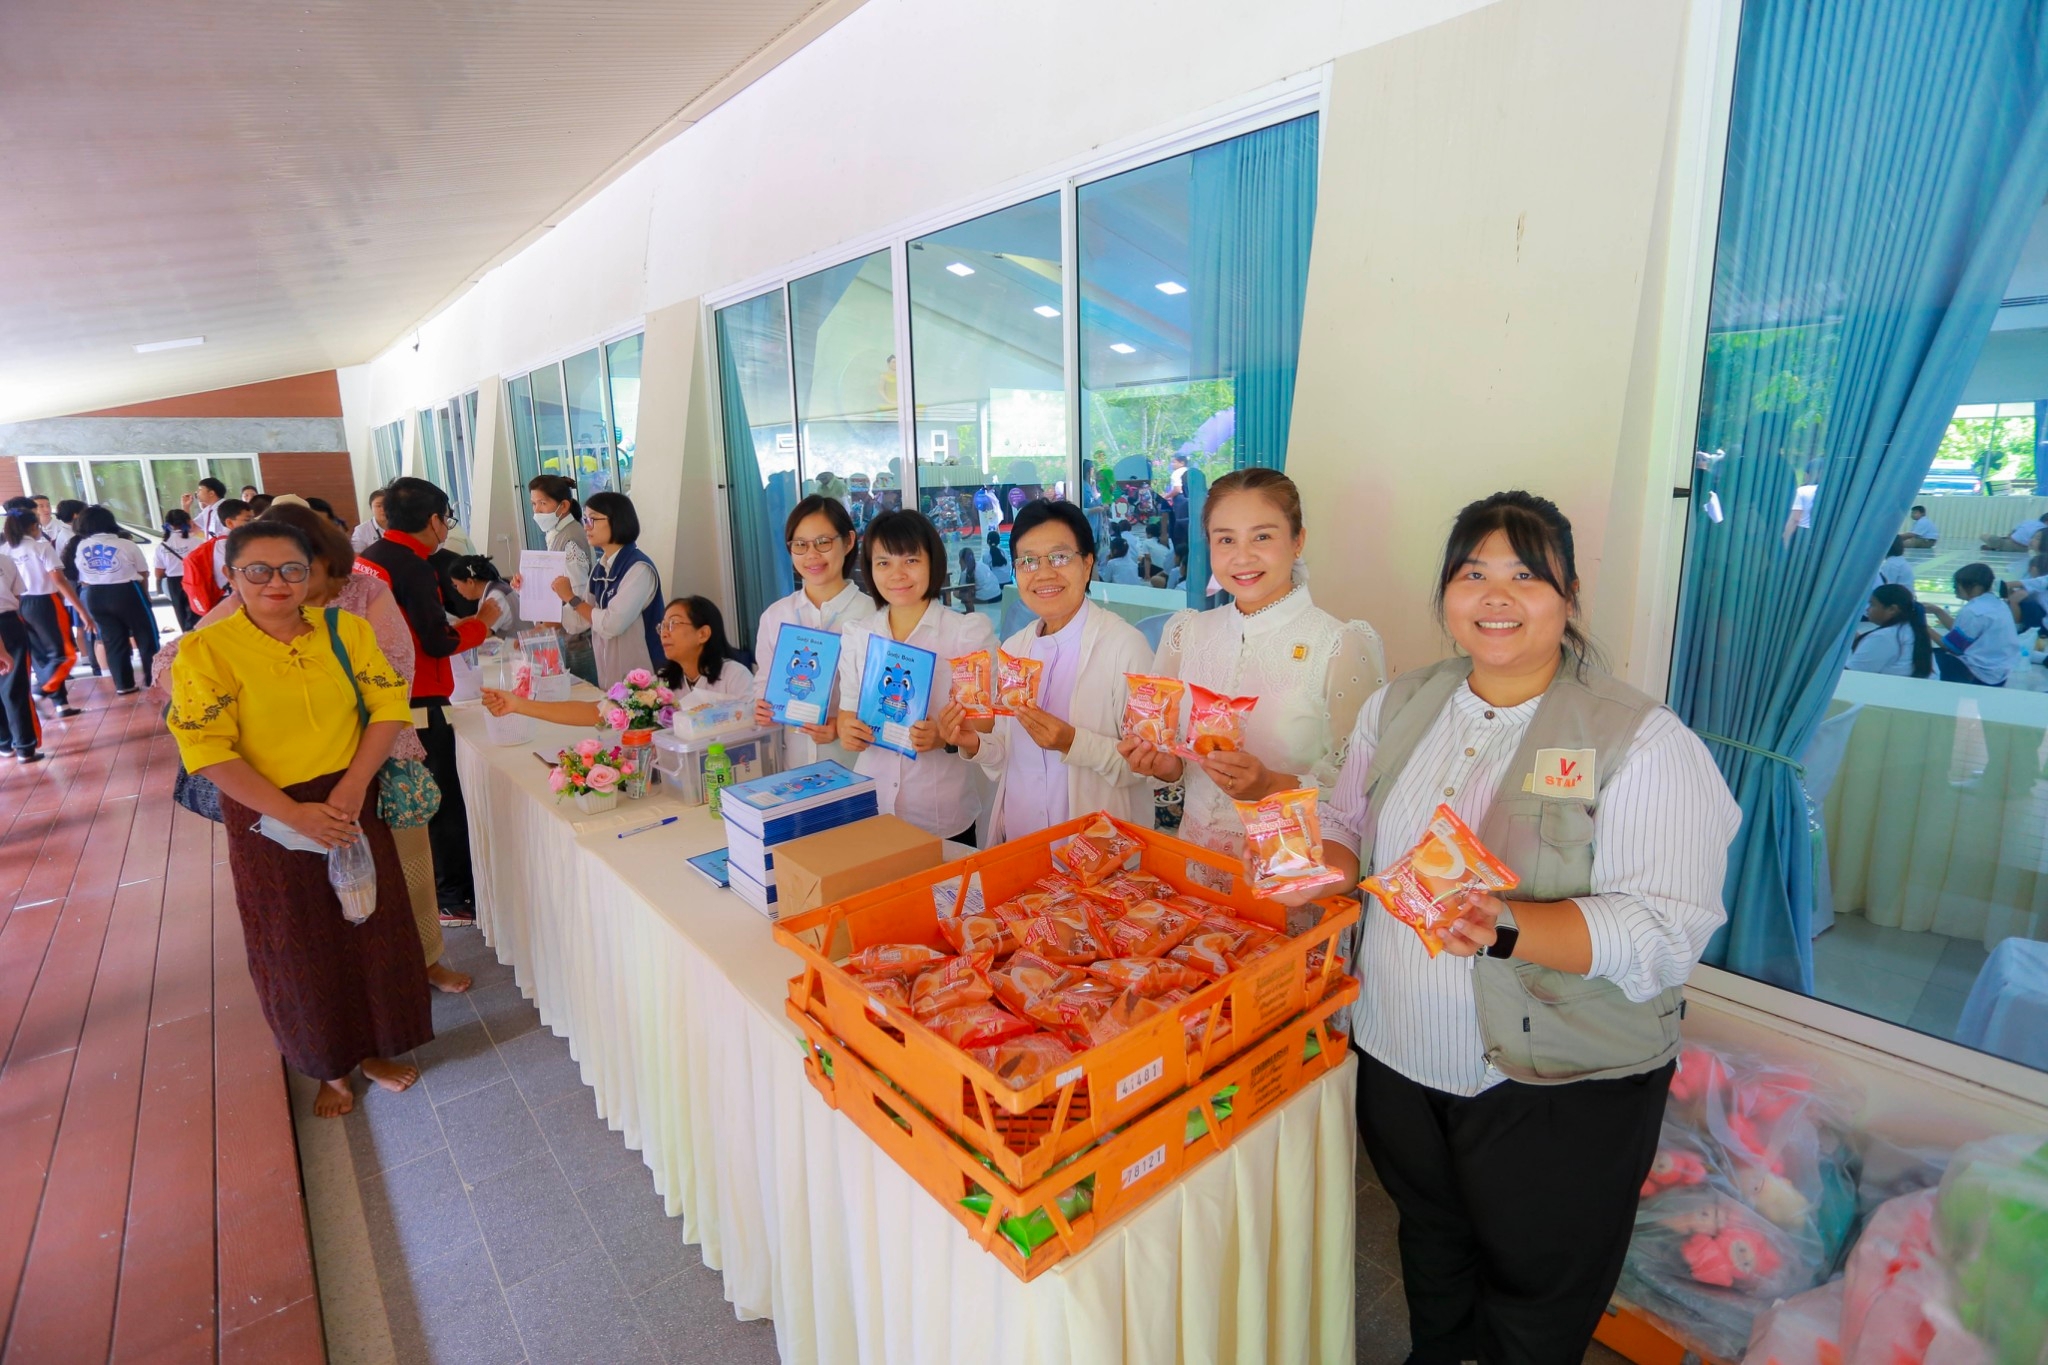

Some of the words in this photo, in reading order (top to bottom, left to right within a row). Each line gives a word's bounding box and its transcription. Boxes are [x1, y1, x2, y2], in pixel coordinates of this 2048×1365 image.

[900, 654, 915, 663] Book
[1560, 757, 1576, 776] V
[717, 774, 724, 783] B
